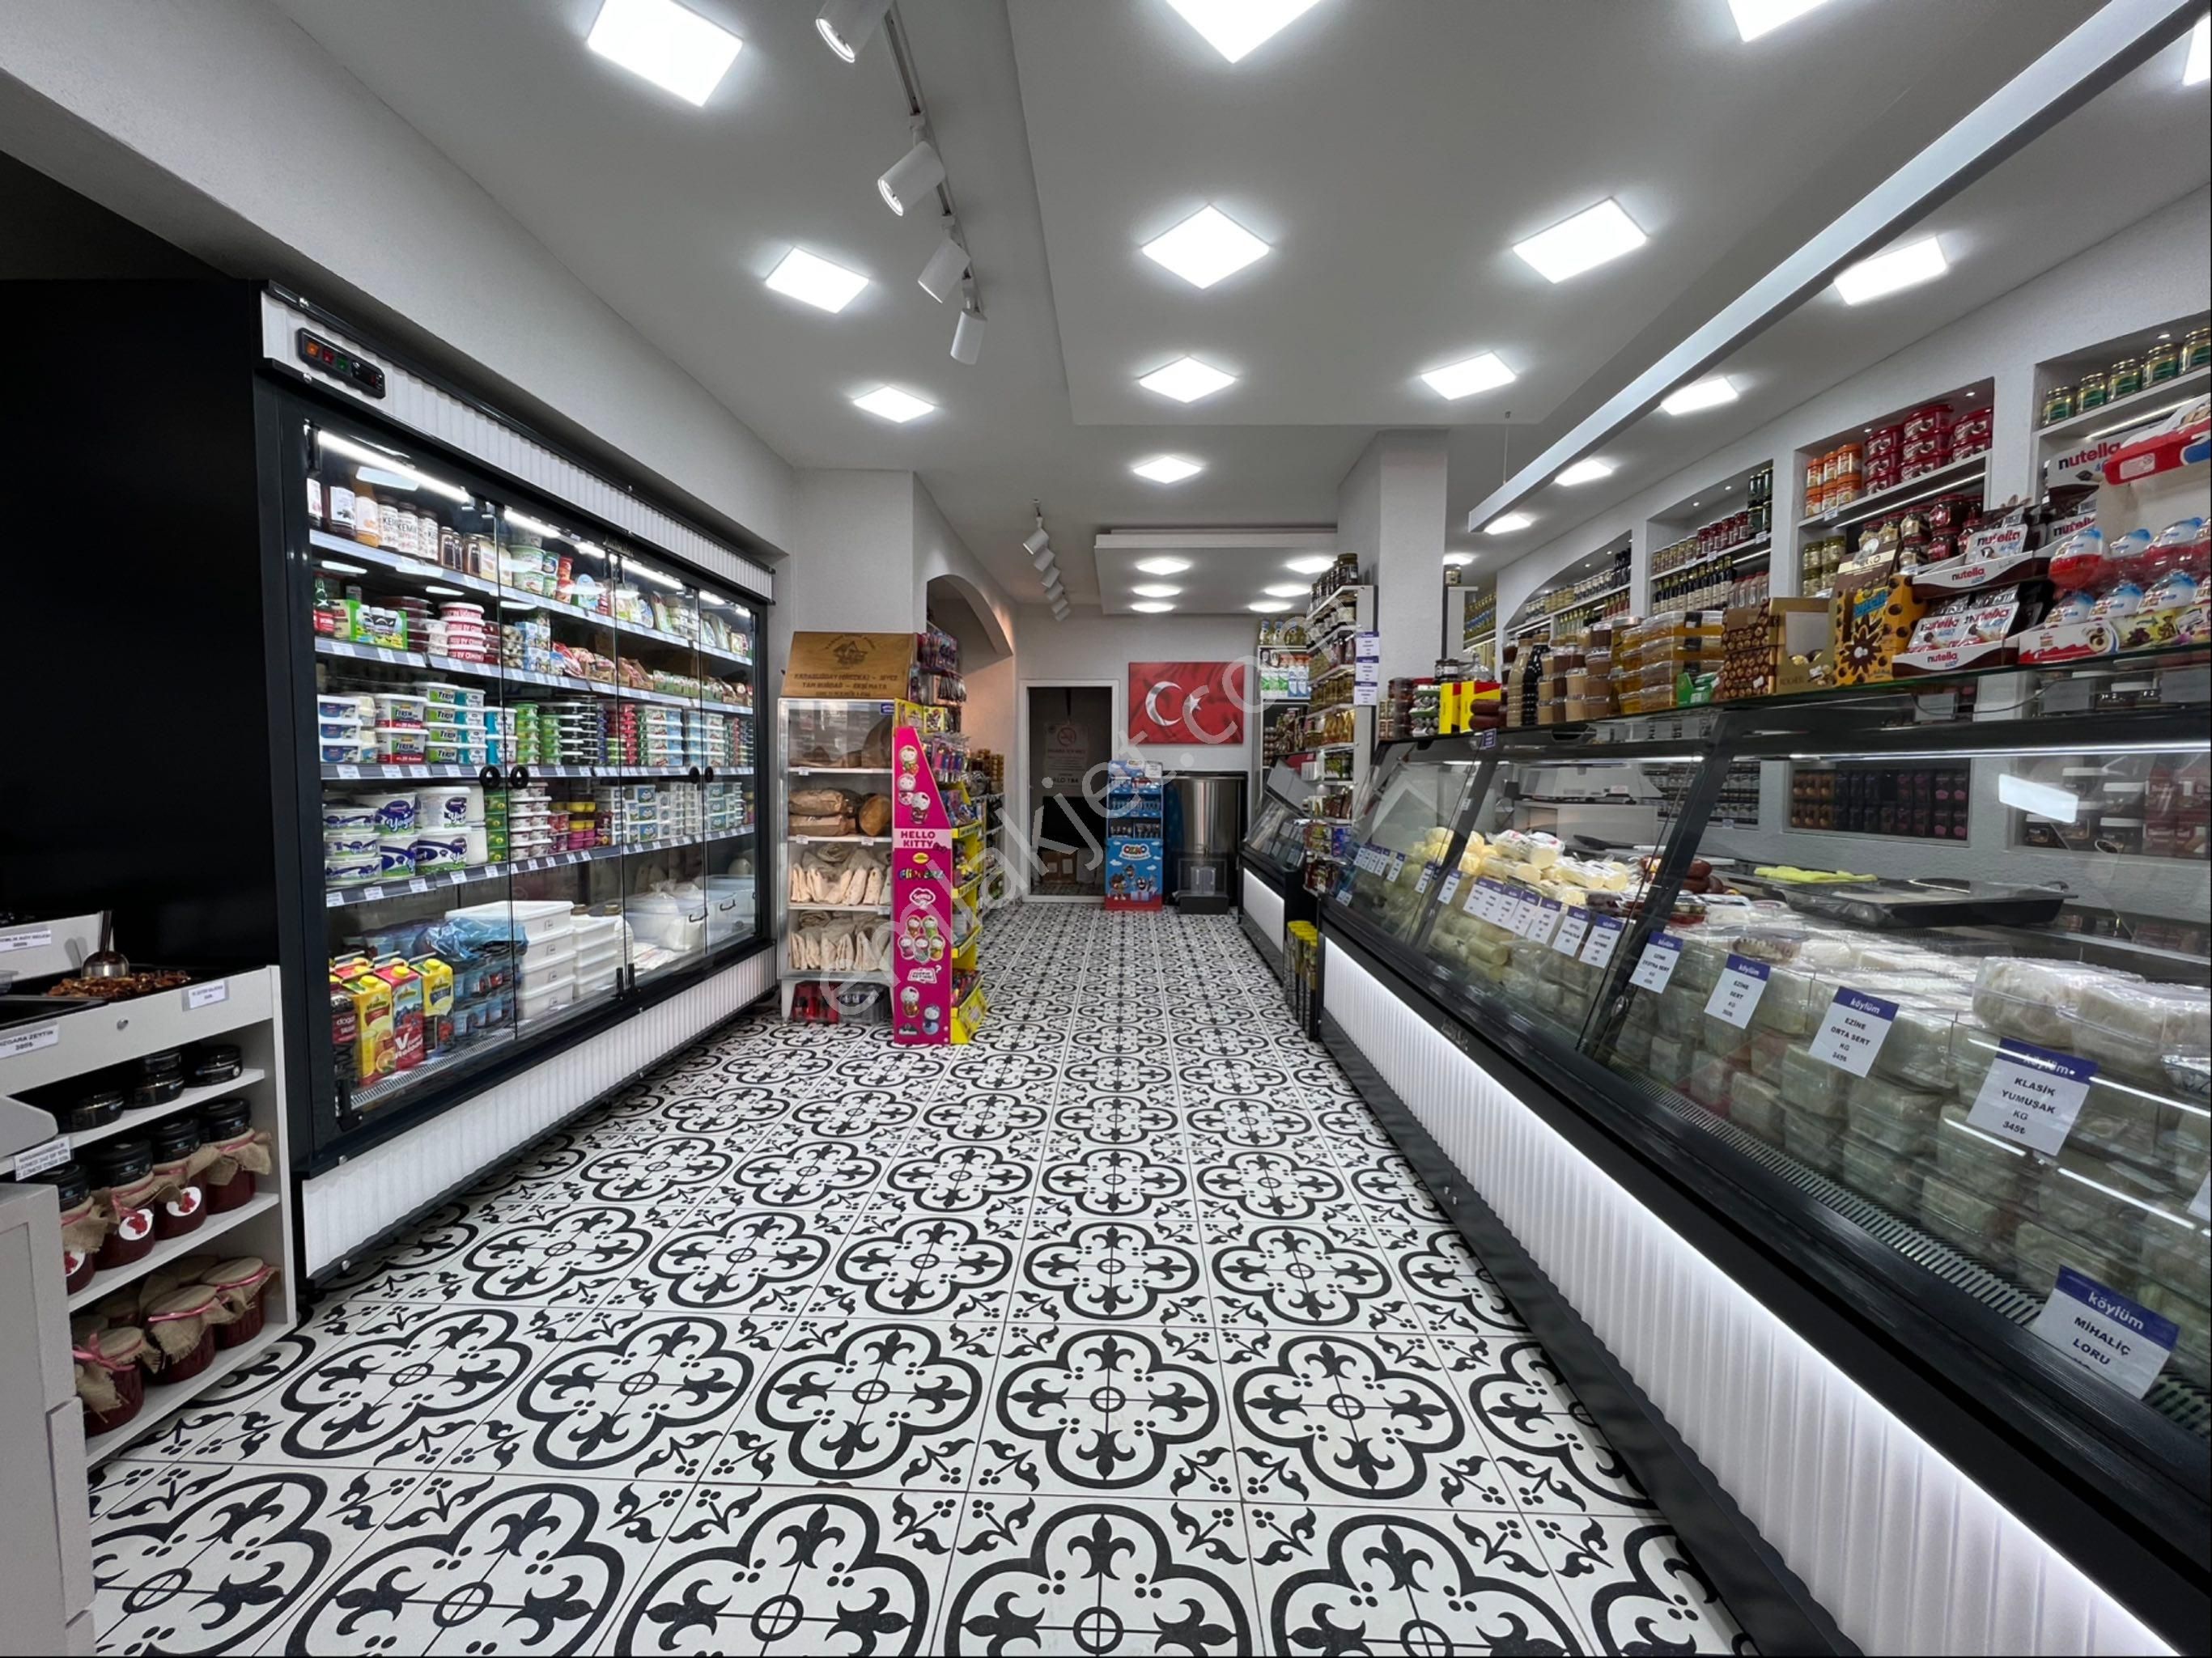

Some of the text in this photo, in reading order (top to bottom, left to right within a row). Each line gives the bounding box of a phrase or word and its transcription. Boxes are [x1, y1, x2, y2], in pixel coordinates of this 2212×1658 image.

[2058, 442, 2121, 470] nutella
[1951, 566, 1985, 581] nutella
[1927, 651, 1958, 664] nutella
[901, 830, 936, 839] HELLO
[1739, 963, 1760, 977] köylüm
[1850, 996, 1880, 1016] köylüm
[1844, 1016, 1866, 1031] EZİNE
[1831, 1026, 1871, 1047] ORTA SERT
[1839, 1042, 1850, 1052] KG
[2014, 1077, 2057, 1097] KLASİK
[2001, 1089, 2057, 1115] YUMUŞAK
[2012, 1109, 2029, 1122] KG
[2087, 1291, 2144, 1331] köylüm
[2074, 1316, 2131, 1357] MİHALİÇ
[2072, 1338, 2111, 1366] LORU
